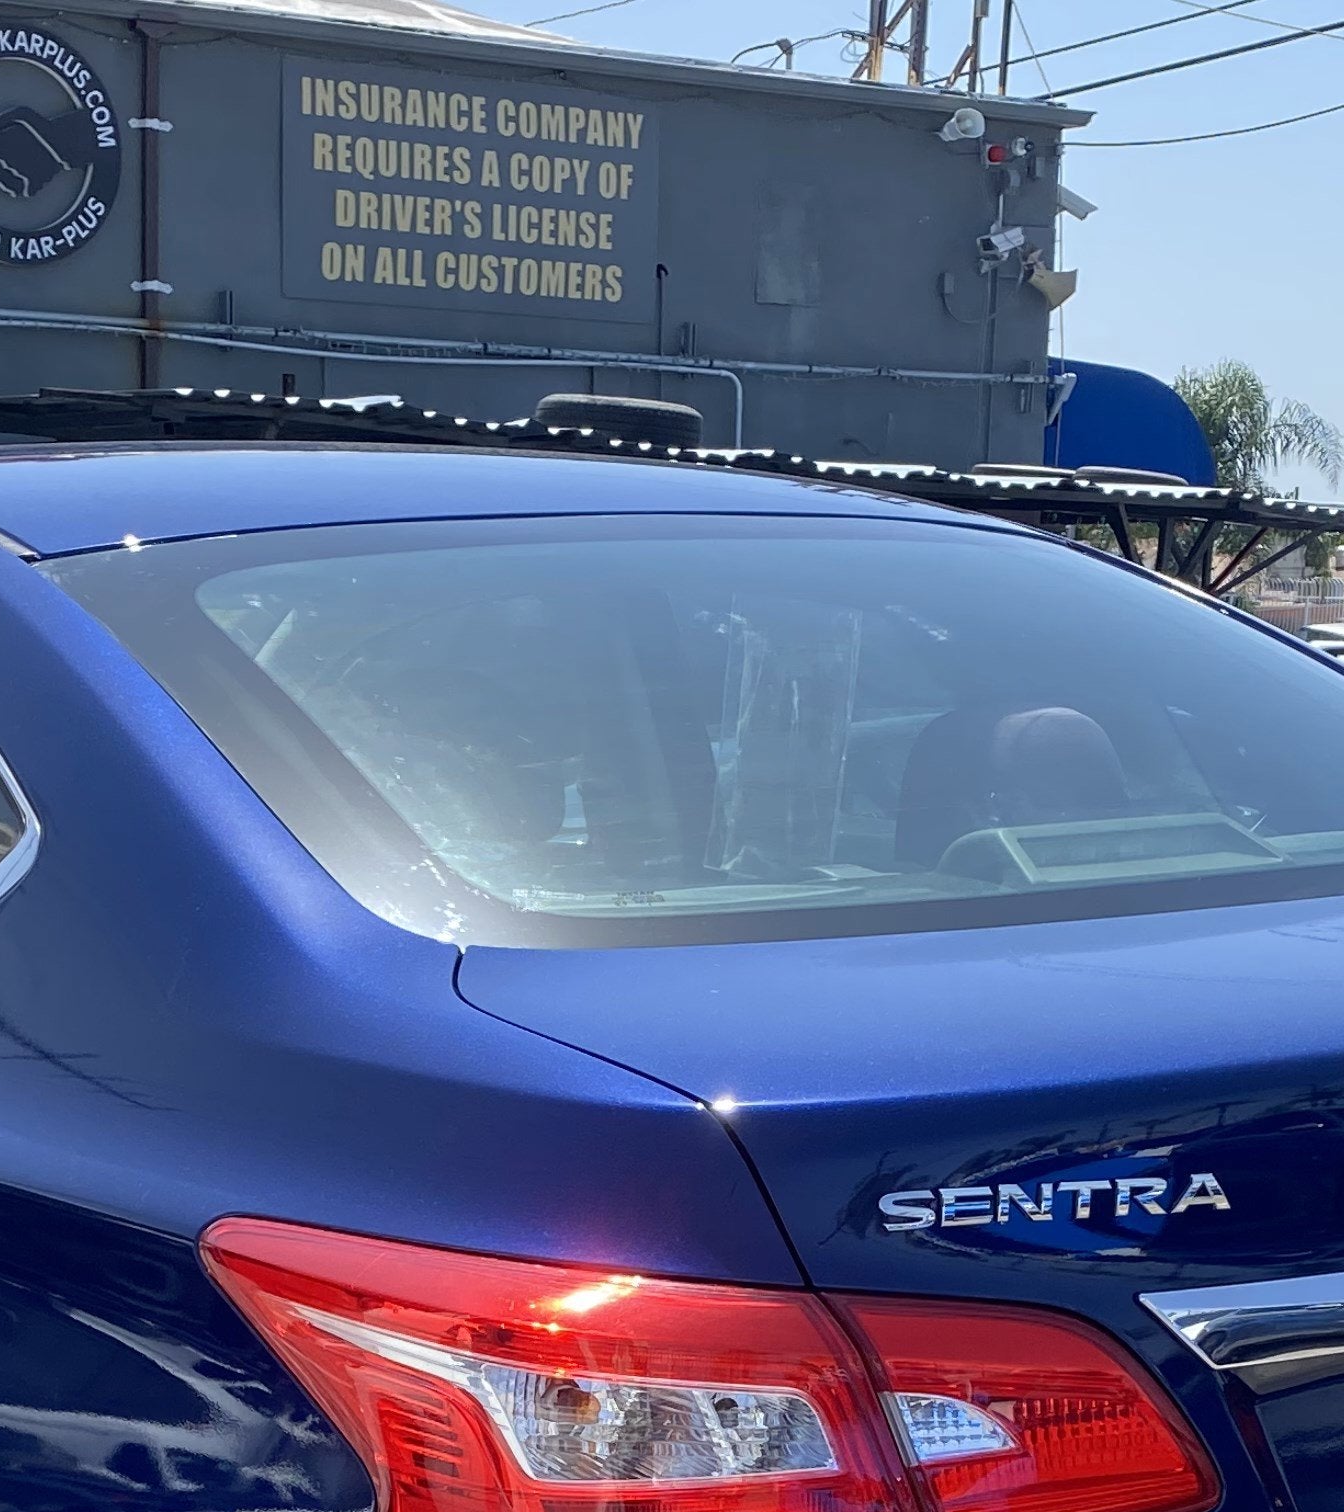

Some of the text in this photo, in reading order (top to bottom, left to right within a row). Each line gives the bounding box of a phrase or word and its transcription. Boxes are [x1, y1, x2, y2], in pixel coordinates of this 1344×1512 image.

[300, 76, 644, 150] INSURANCE COMPANY
[312, 132, 634, 201] REQUIRES A COPY OF
[10, 196, 106, 260] KAR-PLUS
[335, 189, 613, 250] DRIVER'S LICENSE
[321, 242, 623, 303] ON ALL CUSTOMERS
[878, 1171, 1231, 1233] SENTRA
